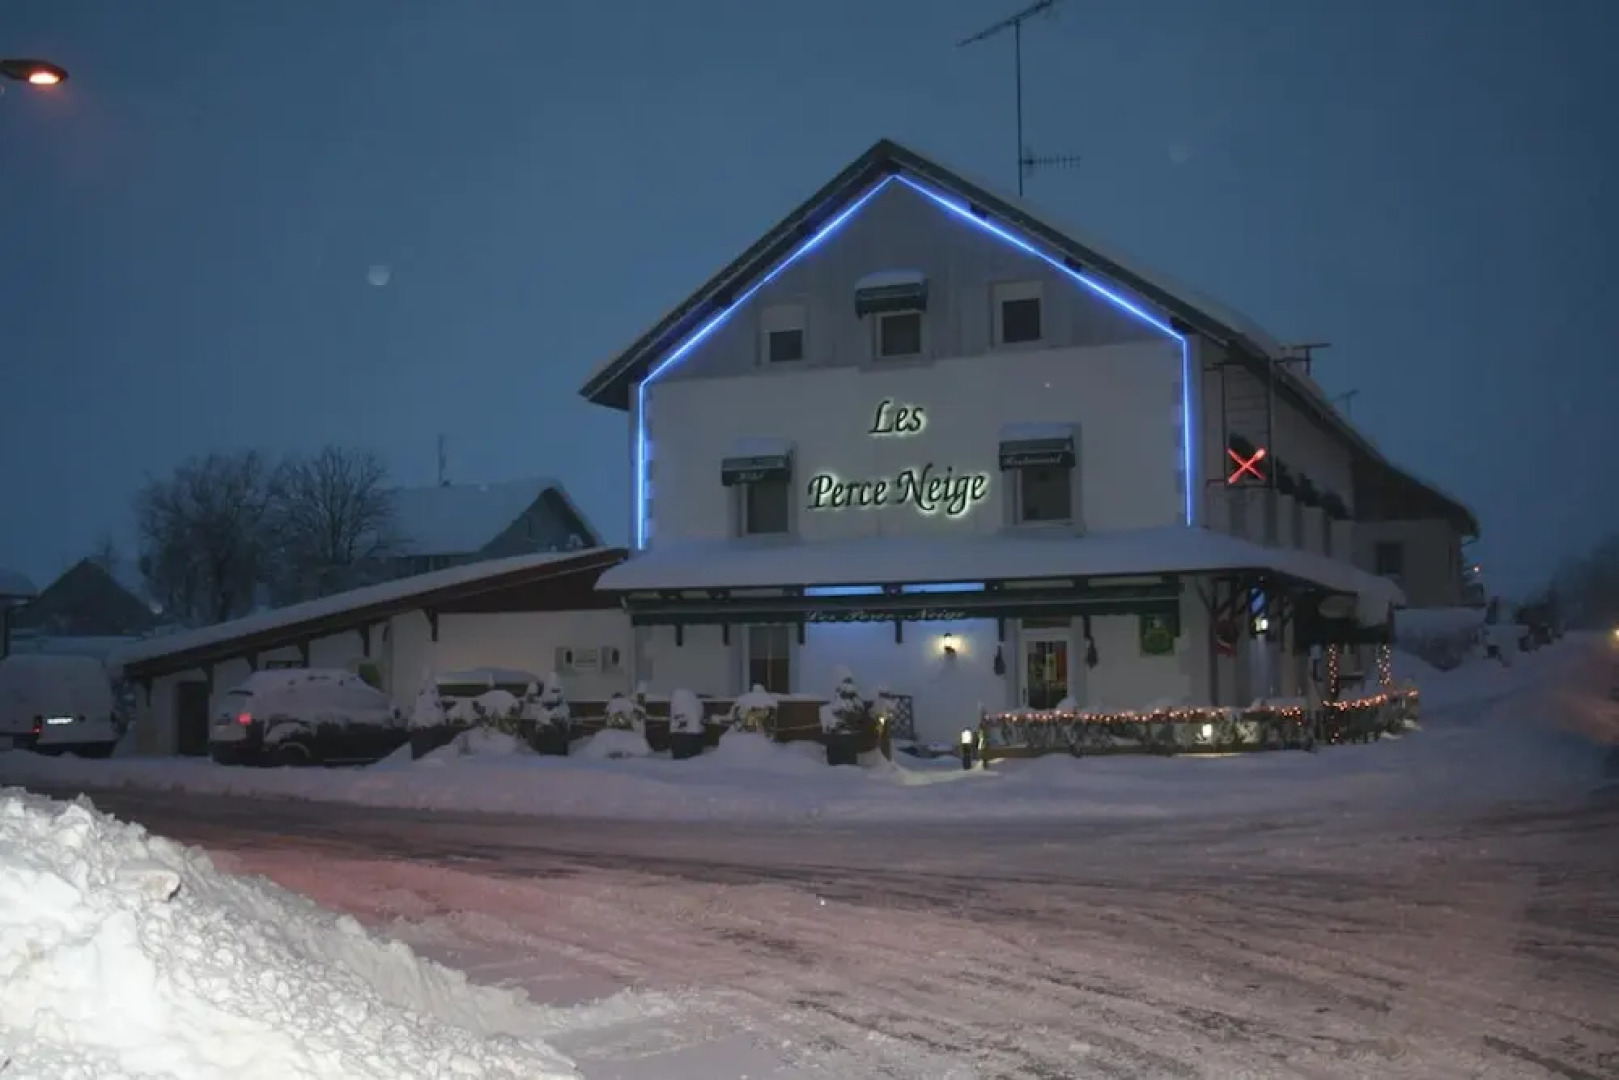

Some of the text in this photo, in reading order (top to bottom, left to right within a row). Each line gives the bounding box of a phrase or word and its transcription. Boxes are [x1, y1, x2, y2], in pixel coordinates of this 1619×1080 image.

[868, 399, 925, 435] Les
[806, 462, 986, 516] Perce Neige
